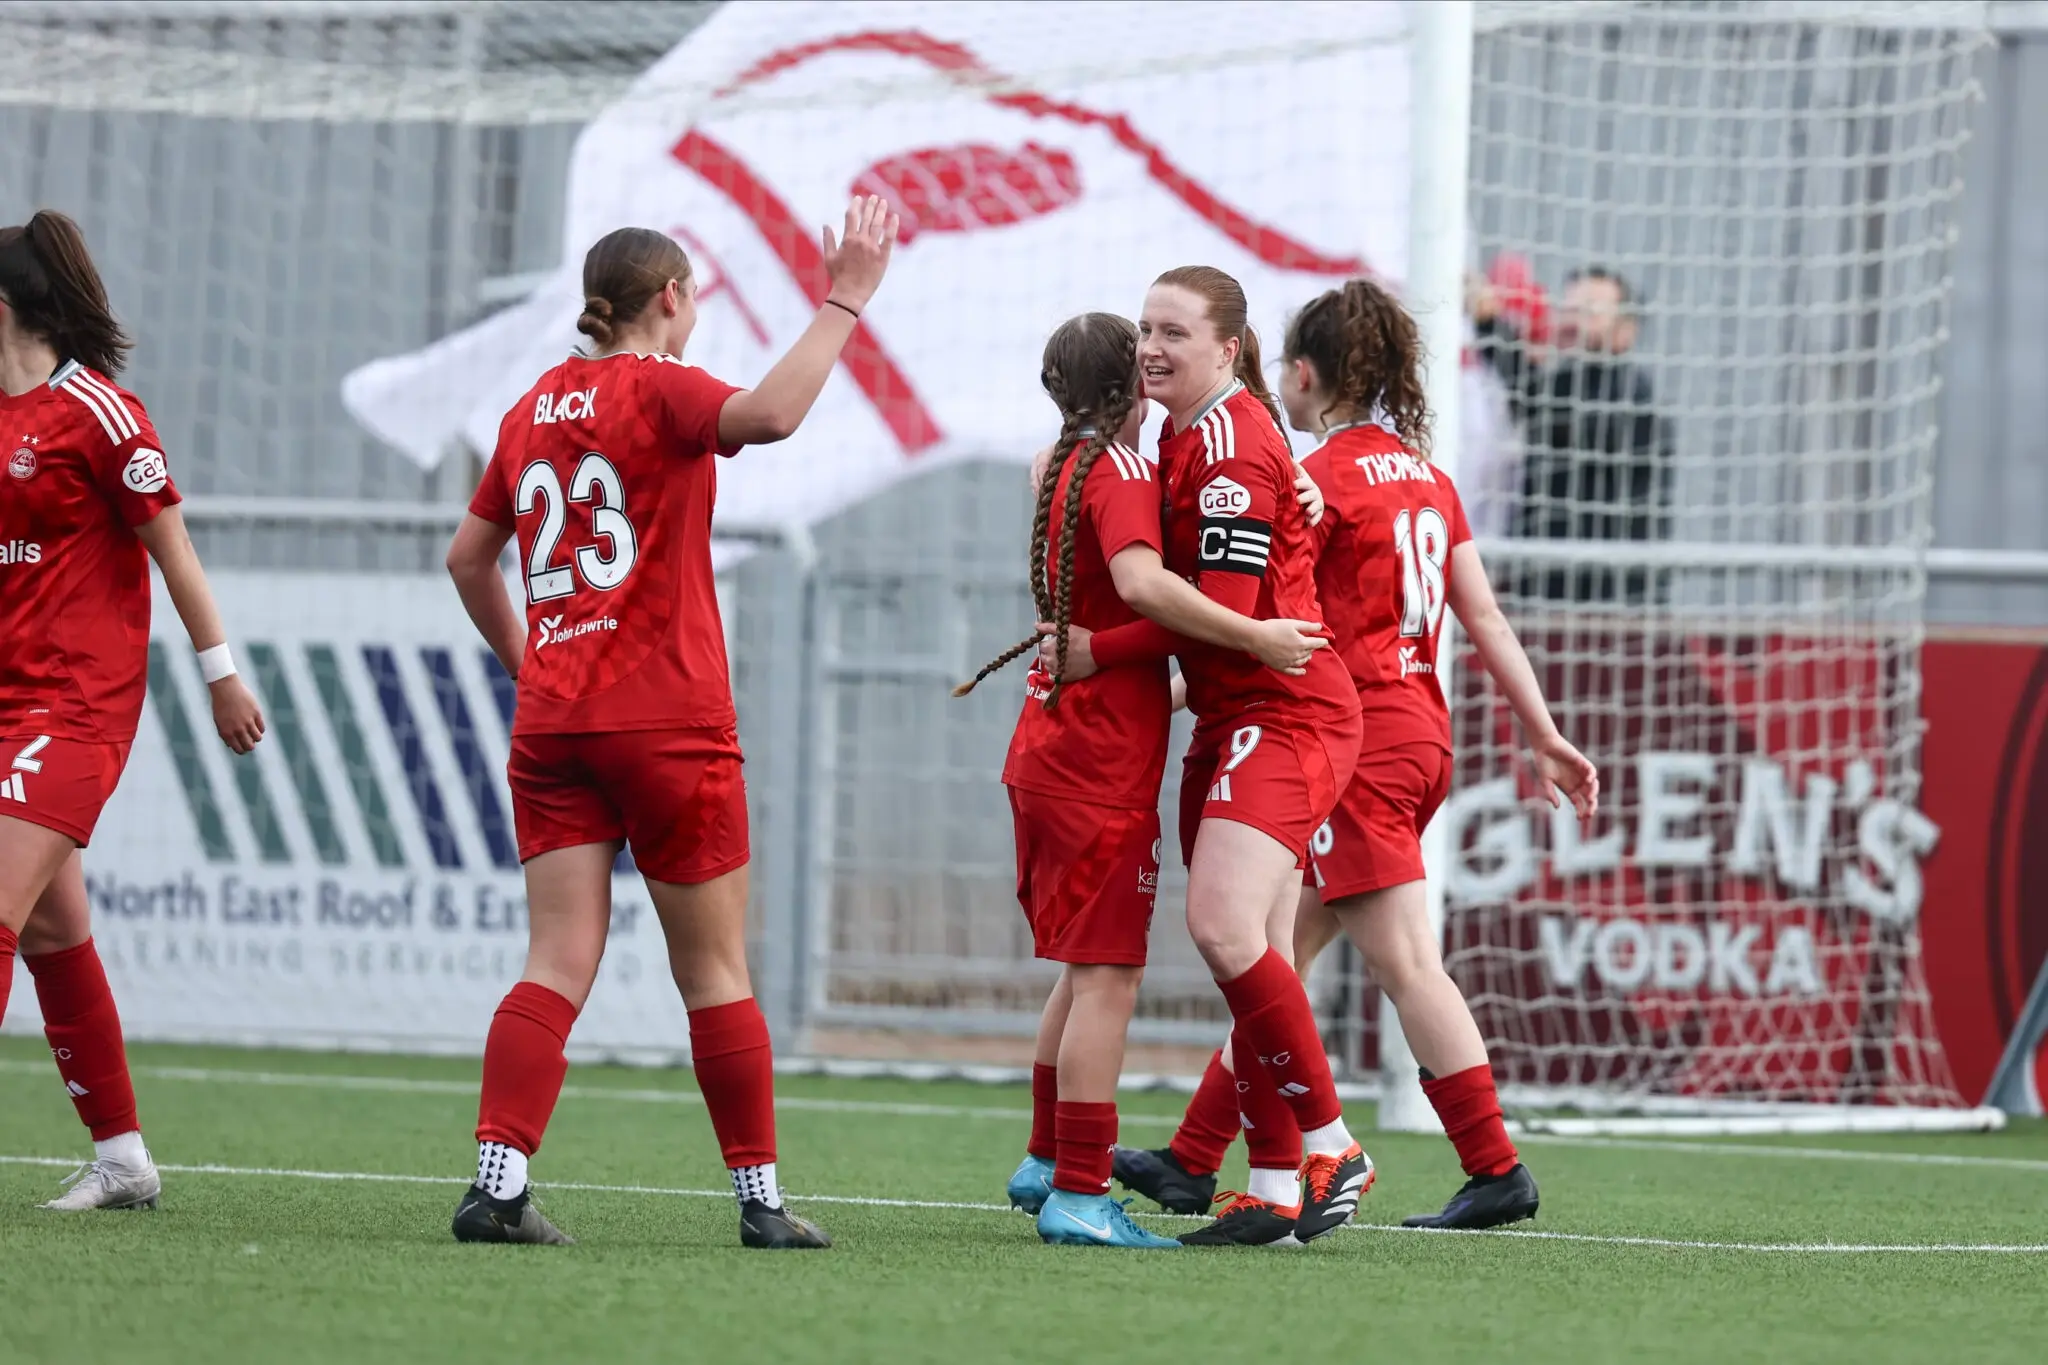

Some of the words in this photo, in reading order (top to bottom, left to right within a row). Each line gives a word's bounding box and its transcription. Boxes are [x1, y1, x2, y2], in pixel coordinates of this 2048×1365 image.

[534, 387, 597, 425] BLACK
[516, 452, 638, 604] 23
[1201, 527, 1227, 560] C
[1393, 507, 1448, 638] 18
[550, 627, 573, 644] John
[574, 616, 618, 637] Lawrie
[11, 734, 52, 774] 2
[1223, 725, 1262, 771] 9
[1446, 751, 1941, 923] GLEN'S
[85, 869, 207, 920] North
[220, 874, 303, 924] East
[317, 877, 419, 928] Roof
[431, 883, 461, 930] &
[1540, 914, 1825, 997] VODKA
